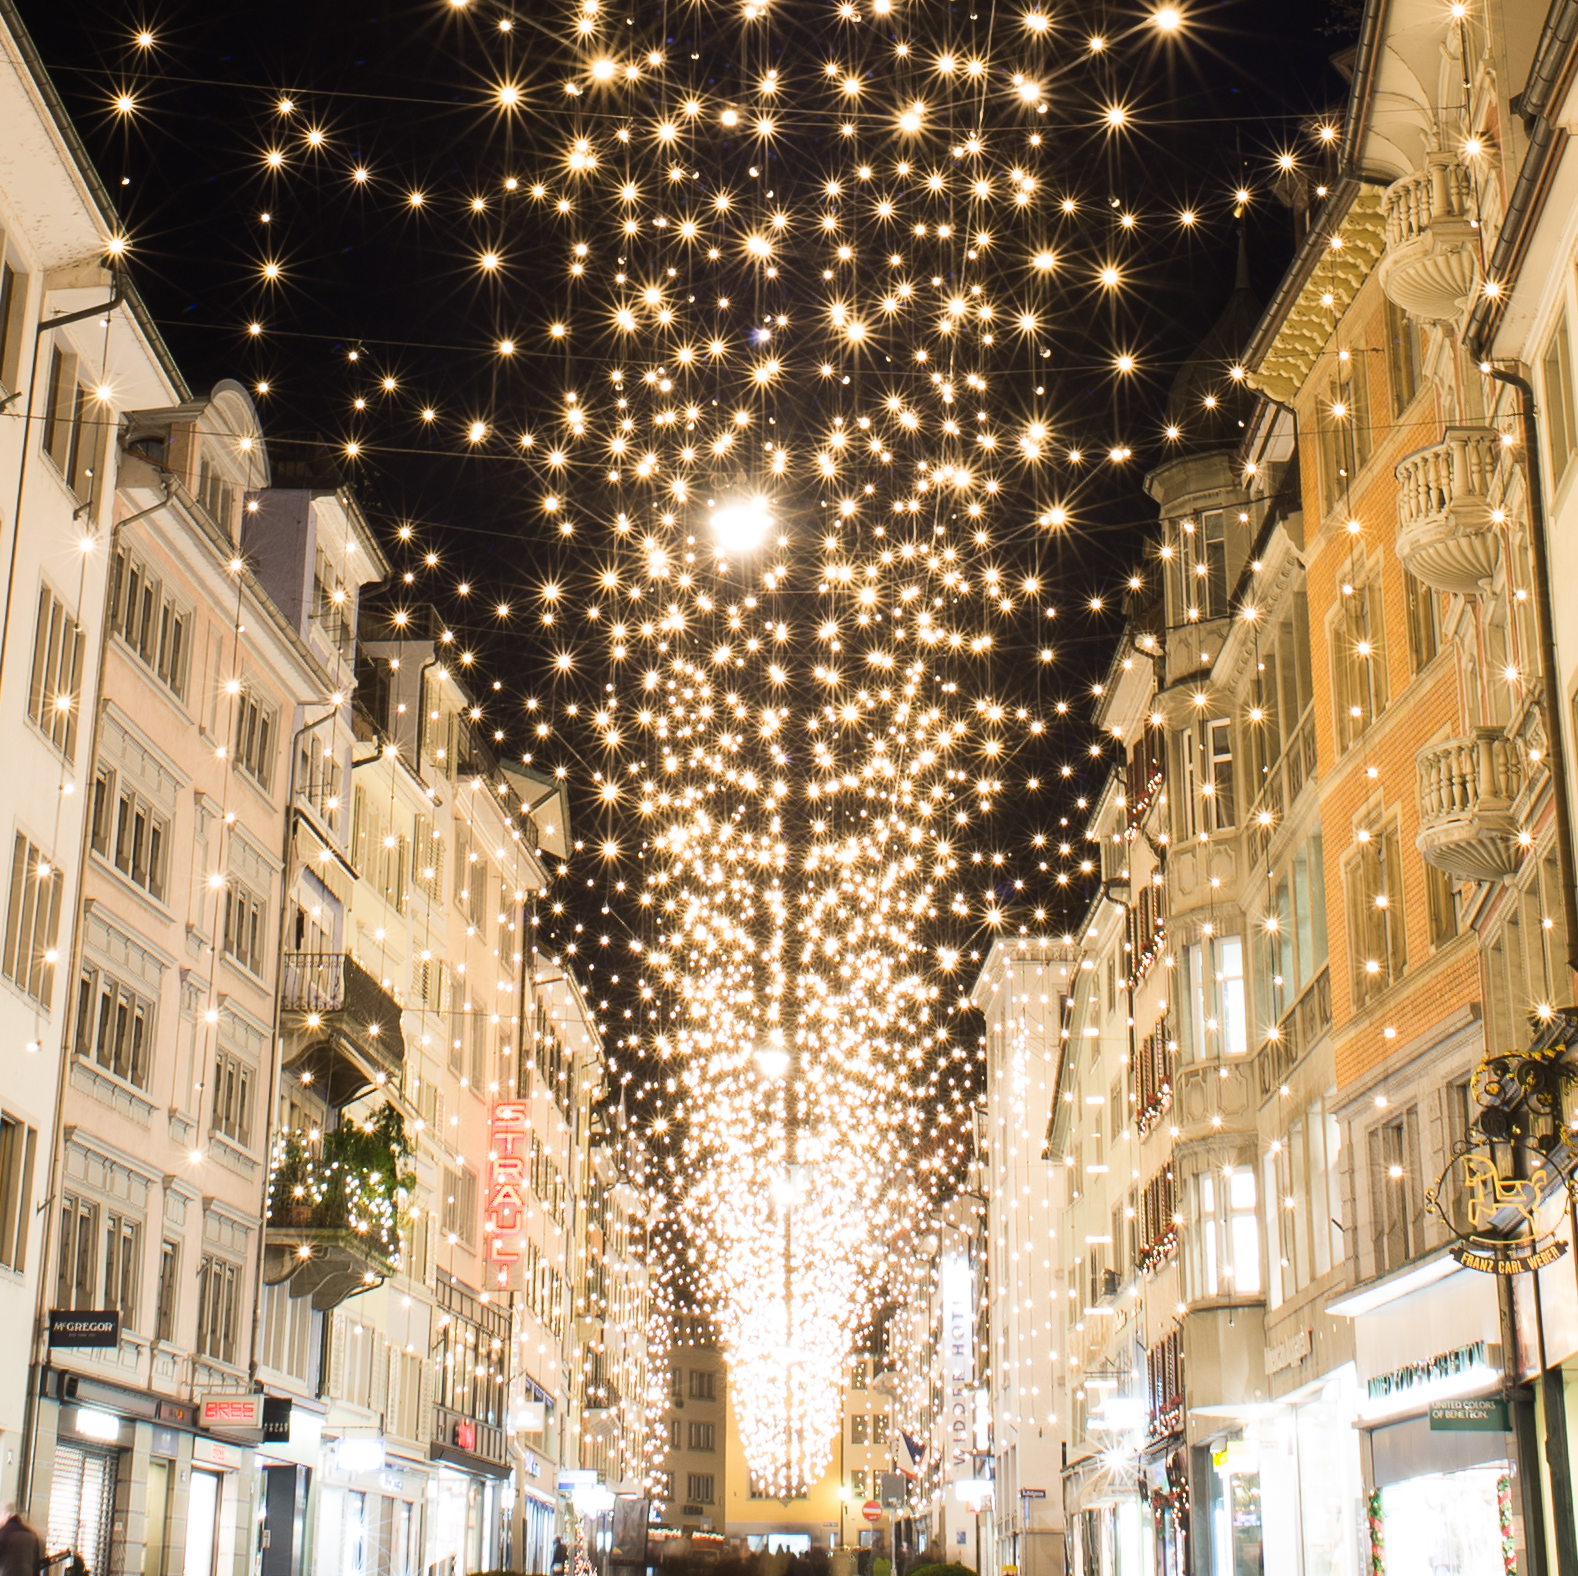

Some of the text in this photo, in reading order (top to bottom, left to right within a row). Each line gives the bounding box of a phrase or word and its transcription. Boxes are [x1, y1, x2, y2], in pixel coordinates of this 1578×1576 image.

[489, 1103, 527, 1289] STRÄULI
[1461, 1246, 1561, 1274] FRANZ CARL WEBER
[204, 1402, 255, 1420] BREE
[1432, 1401, 1496, 1410] UNITED COLORS
[1432, 1410, 1443, 1419] OF
